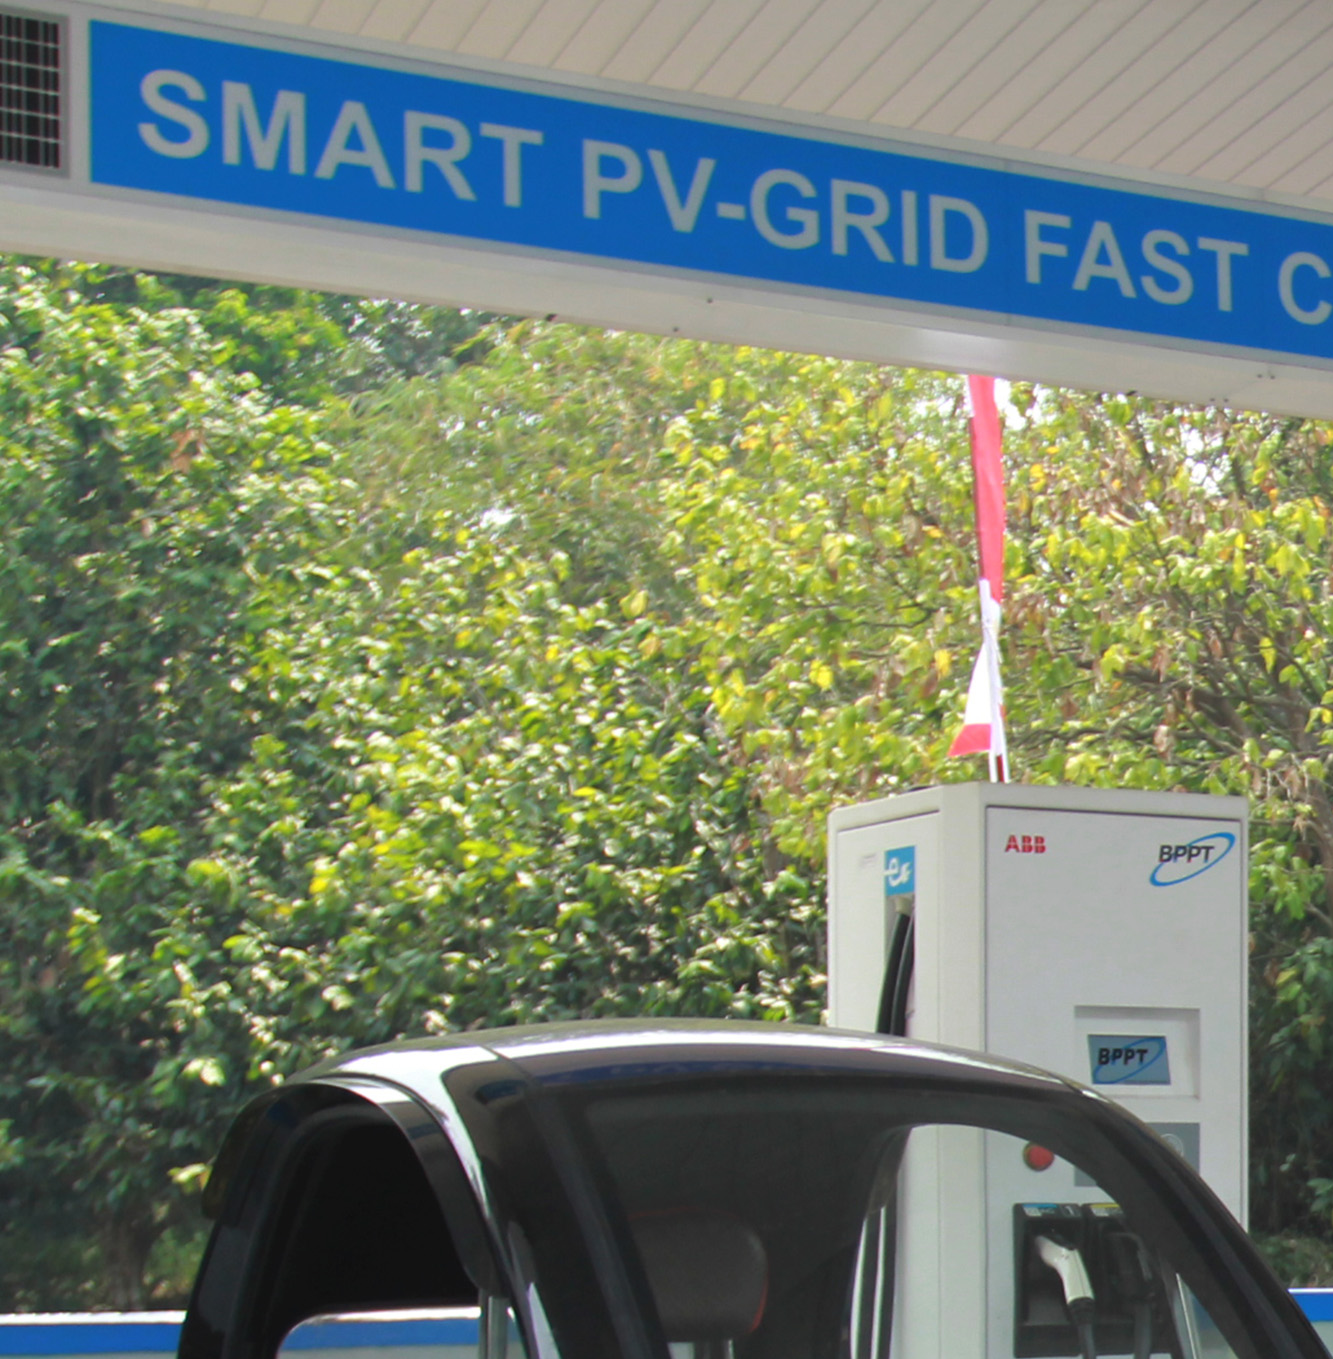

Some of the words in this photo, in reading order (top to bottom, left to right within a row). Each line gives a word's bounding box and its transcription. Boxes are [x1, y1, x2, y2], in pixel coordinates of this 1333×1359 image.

[137, 69, 544, 208] SMART
[581, 138, 989, 275] PV-GRID
[1024, 208, 1249, 313] FAST
[1005, 835, 1046, 854] ABB
[1158, 845, 1215, 864] BPPT
[1097, 1047, 1149, 1066] BPPT
